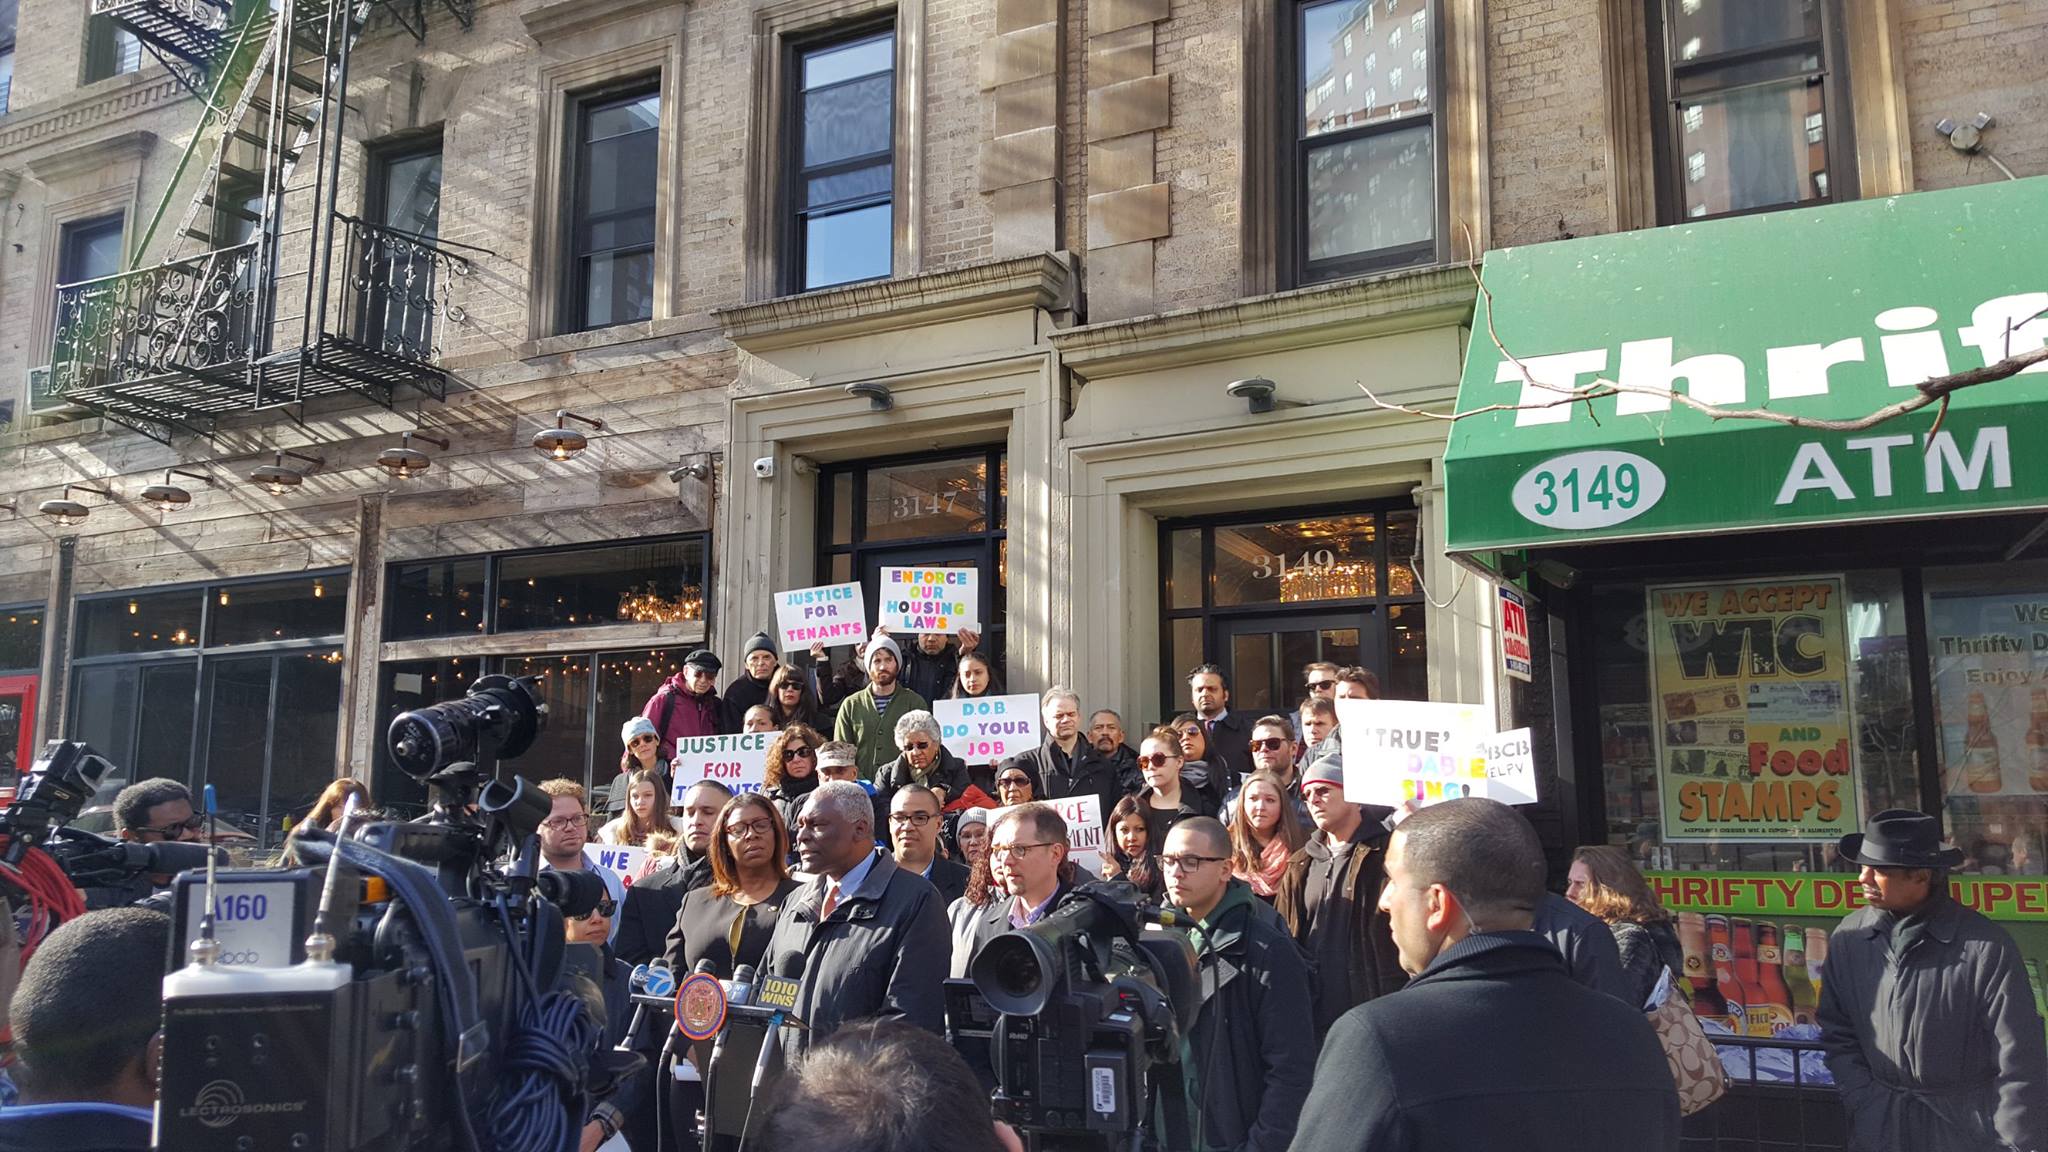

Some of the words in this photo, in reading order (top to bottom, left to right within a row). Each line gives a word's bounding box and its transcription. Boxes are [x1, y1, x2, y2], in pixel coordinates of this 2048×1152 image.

[1774, 426, 2012, 505] ATM
[1534, 463, 1640, 516] 3149
[893, 491, 959, 518] 3147
[1252, 549, 1336, 580] 3149
[891, 570, 967, 585] ENFORCE
[787, 586, 853, 606] JUSTICE
[910, 586, 943, 599] OUR
[1660, 591, 1708, 617] WE
[1719, 584, 1832, 615] ACCEPT
[804, 604, 838, 620] FOR
[886, 601, 965, 615] HOUSING
[904, 616, 948, 630] LAWS
[1504, 600, 1527, 639] ATM
[787, 622, 863, 642] TENANTS
[1669, 614, 1826, 680] WIC
[1939, 633, 2024, 656] Thrifty
[1966, 667, 2032, 686] Enjoy
[943, 724, 968, 738] DO
[978, 720, 1030, 735] YOUR
[1779, 727, 1822, 743] AND
[679, 734, 765, 754] JUSTICE
[968, 741, 1005, 756] JOB
[1408, 753, 1488, 780] DABLE
[1748, 739, 1850, 777] Food
[704, 762, 742, 778] FOR
[1679, 780, 1842, 822] STAMPS
[600, 850, 630, 871] WE
[1647, 877, 1804, 909] HRIFTY
[1814, 879, 1864, 910] DE
[1950, 882, 2048, 914] UPE
[765, 978, 798, 995] 1010
[761, 991, 794, 1007] WINS
[180, 1101, 303, 1117] LECTROSONICS
